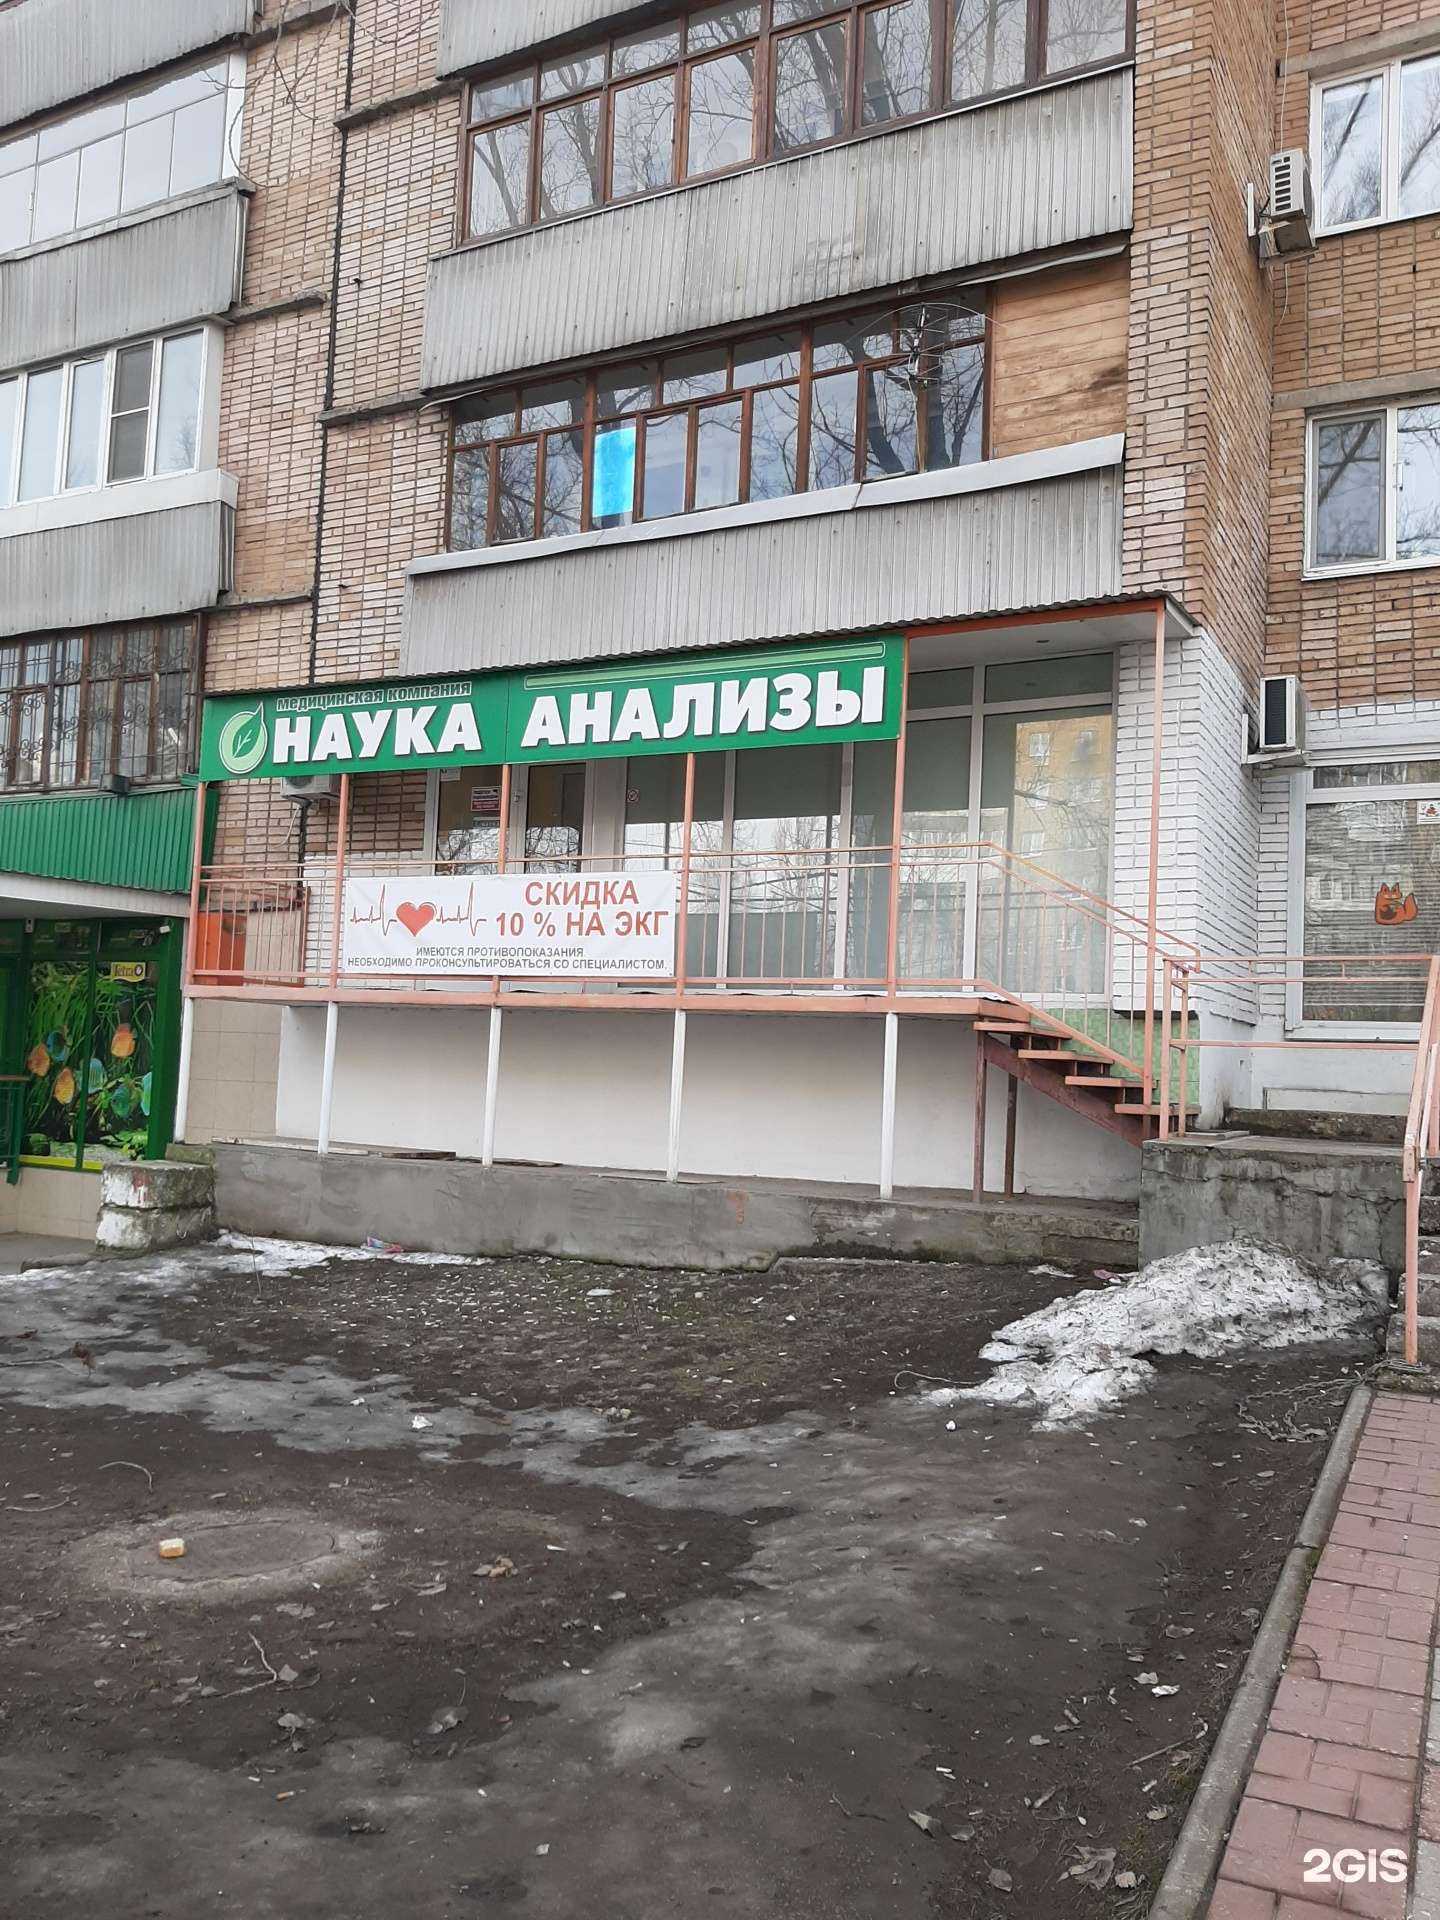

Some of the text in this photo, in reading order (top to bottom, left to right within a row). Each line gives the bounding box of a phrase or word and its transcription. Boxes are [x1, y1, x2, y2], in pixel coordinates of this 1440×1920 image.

[387, 681, 472, 702] компания
[520, 666, 886, 748] АНАЛИЗЫ
[273, 703, 482, 763] НАУКА
[525, 880, 639, 910] СКИДКА
[496, 911, 669, 937] 10 % НА ЭКГ
[347, 957, 412, 967] НЕОБХОДИМО
[415, 958, 551, 969] ПРОКОНСУЛЬТИРОВАТЬСЯ
[553, 959, 569, 968] СО
[416, 946, 584, 957] ИМЕЮТСЯ ПРОТИВОПОКАЗАНИЯ
